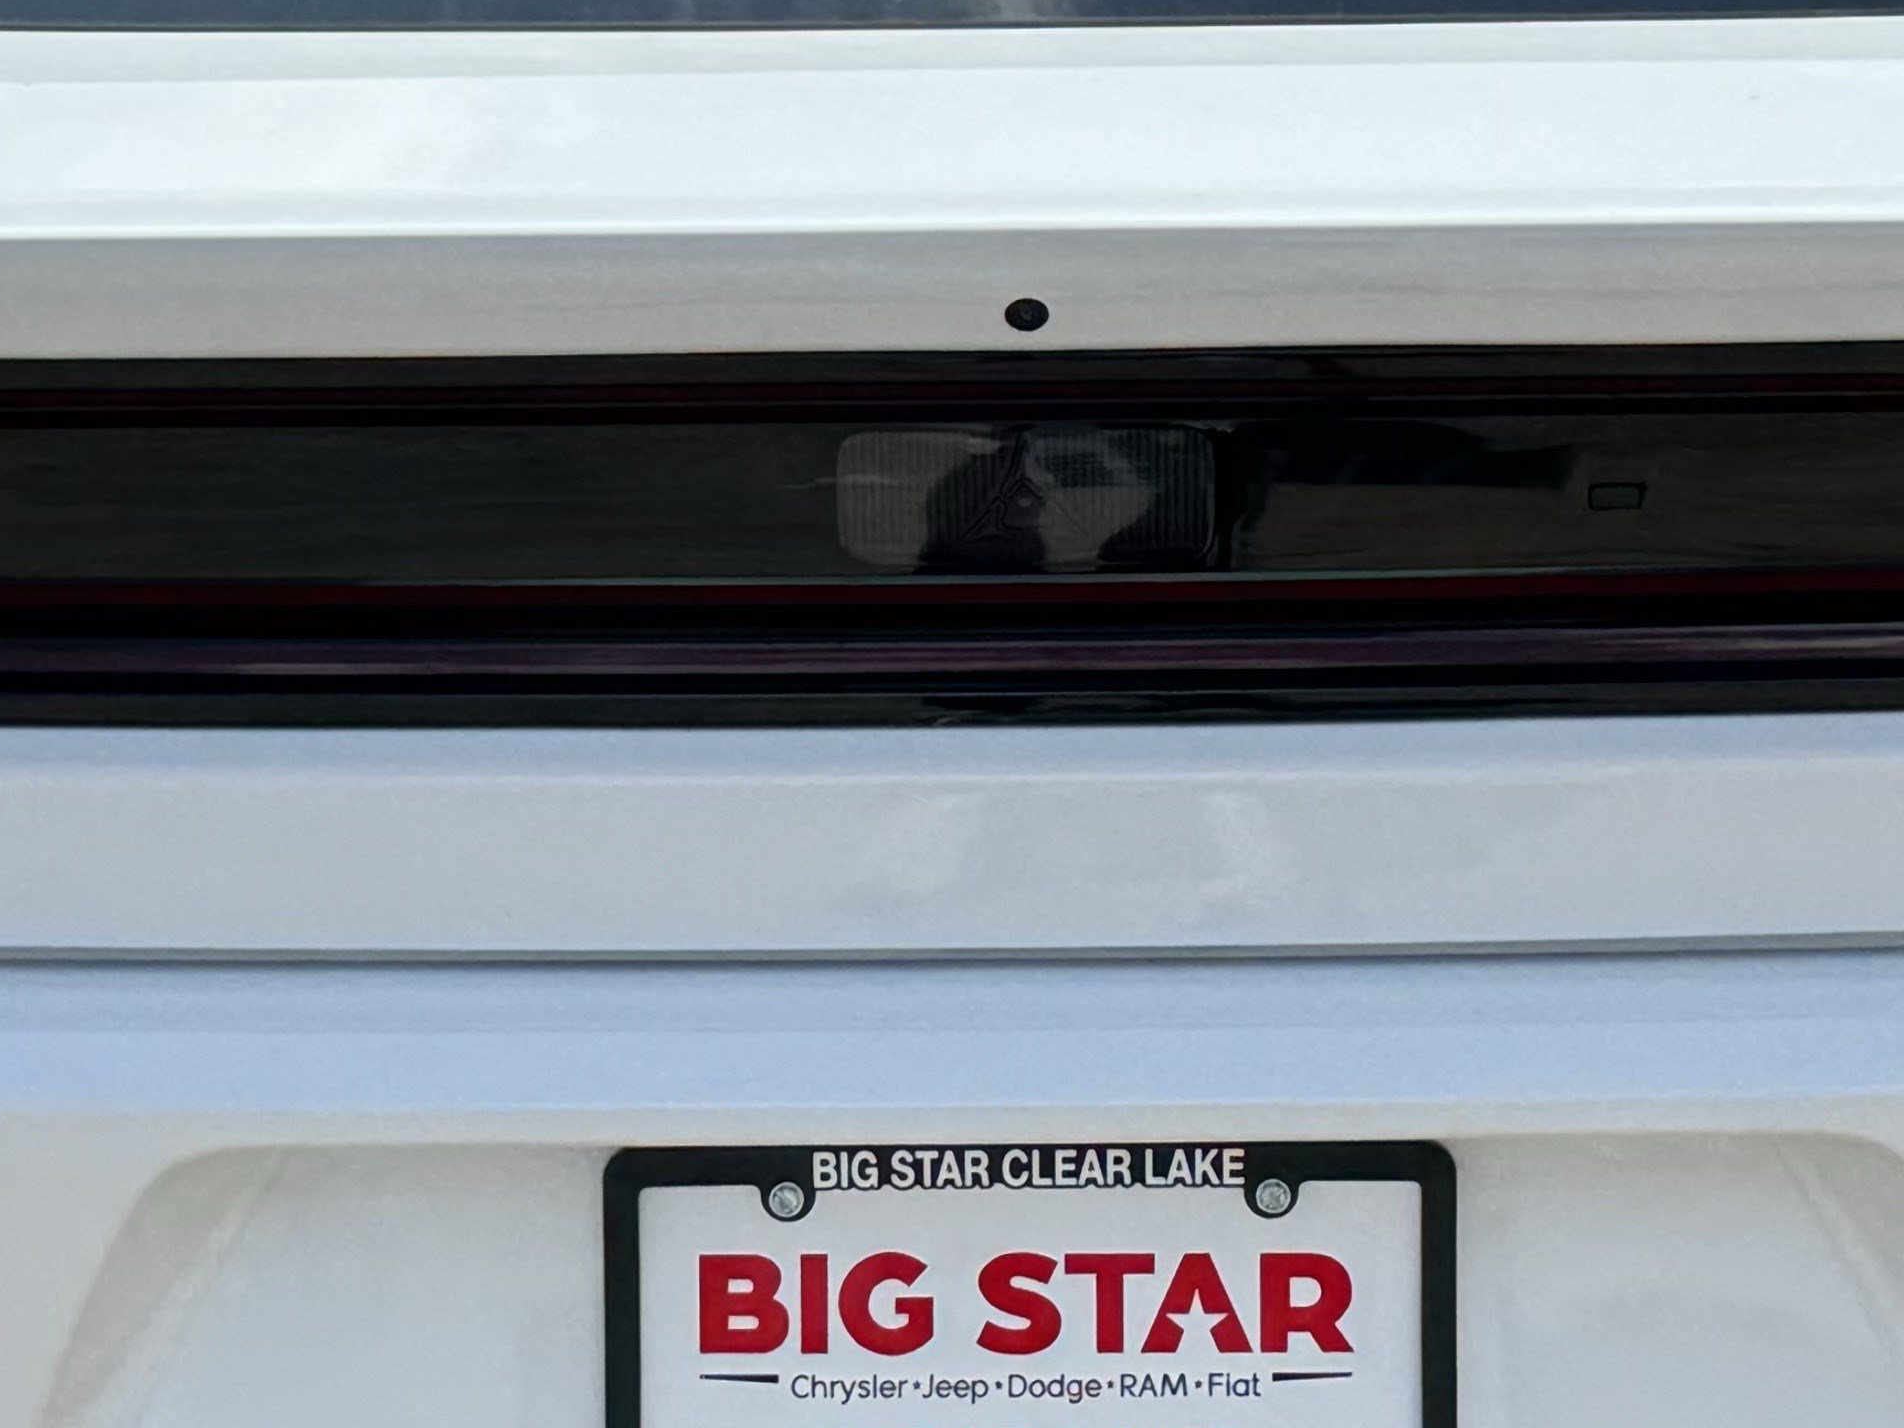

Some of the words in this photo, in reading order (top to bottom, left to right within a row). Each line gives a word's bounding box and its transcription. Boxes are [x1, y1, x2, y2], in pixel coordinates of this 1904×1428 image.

[812, 1150, 879, 1189] BIG
[889, 1149, 991, 1188] STAR
[1001, 1148, 1133, 1187] CLEAR
[1144, 1147, 1246, 1185] LAKE
[699, 1252, 934, 1356] BIG
[976, 1252, 1355, 1356] STAR
[790, 1373, 909, 1406] Chrysler
[921, 1373, 990, 1405] Jeep
[1007, 1373, 1103, 1404] Dodge
[1120, 1372, 1189, 1398] RAM
[1207, 1372, 1262, 1398] Fiat
